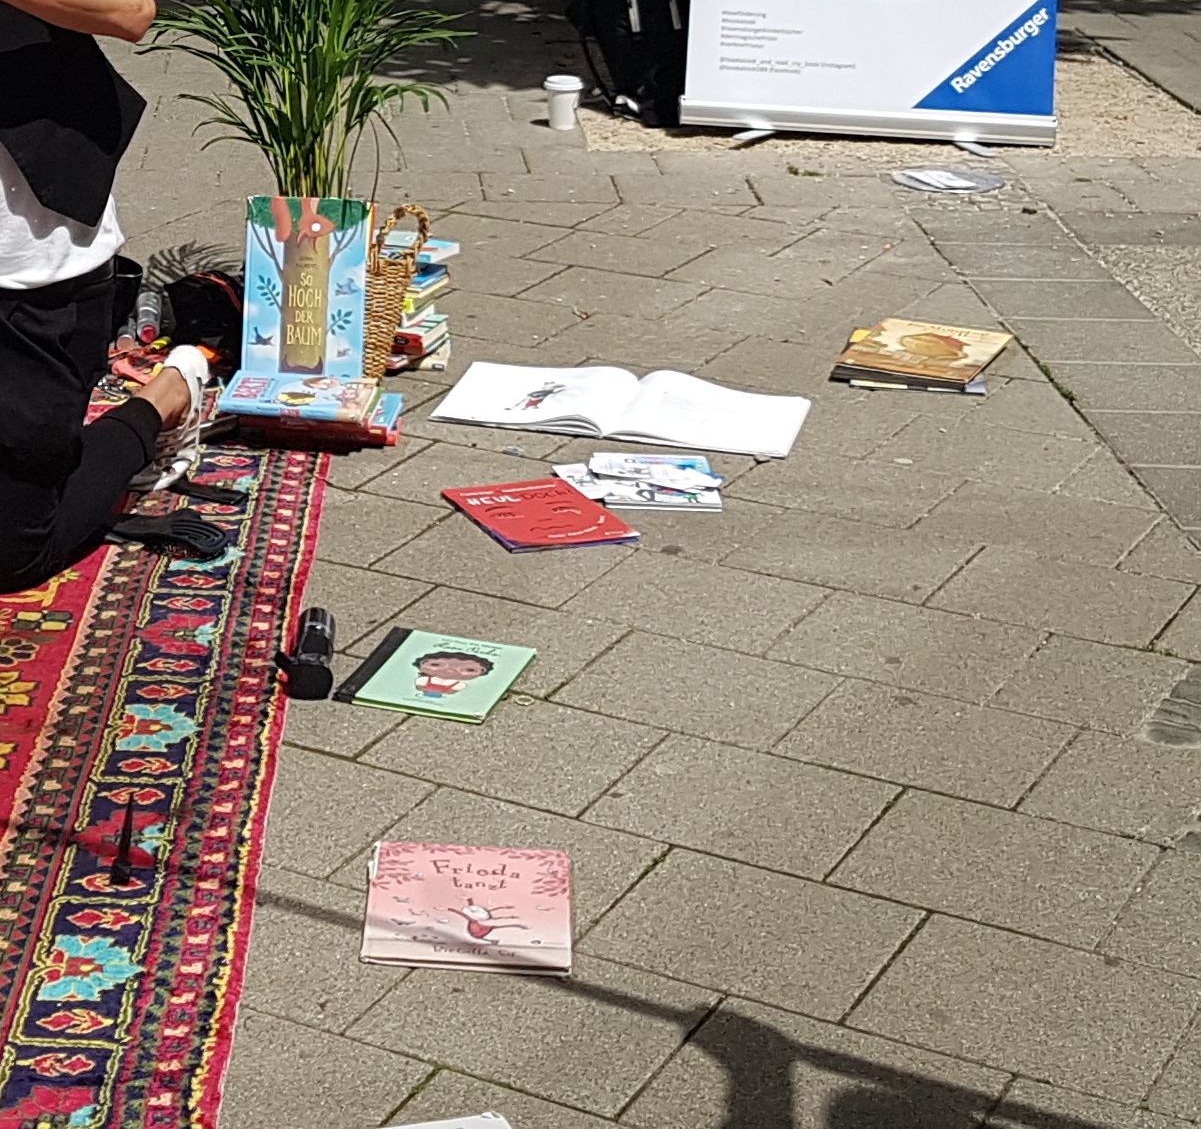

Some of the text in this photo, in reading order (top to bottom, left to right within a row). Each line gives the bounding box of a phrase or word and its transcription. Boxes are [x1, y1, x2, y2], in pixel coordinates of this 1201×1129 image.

[950, 7, 1049, 94] Ravensburger
[288, 285, 322, 309] HOCH
[294, 309, 314, 324] DER
[286, 324, 322, 347] BAUM
[452, 876, 508, 891] tanzt
